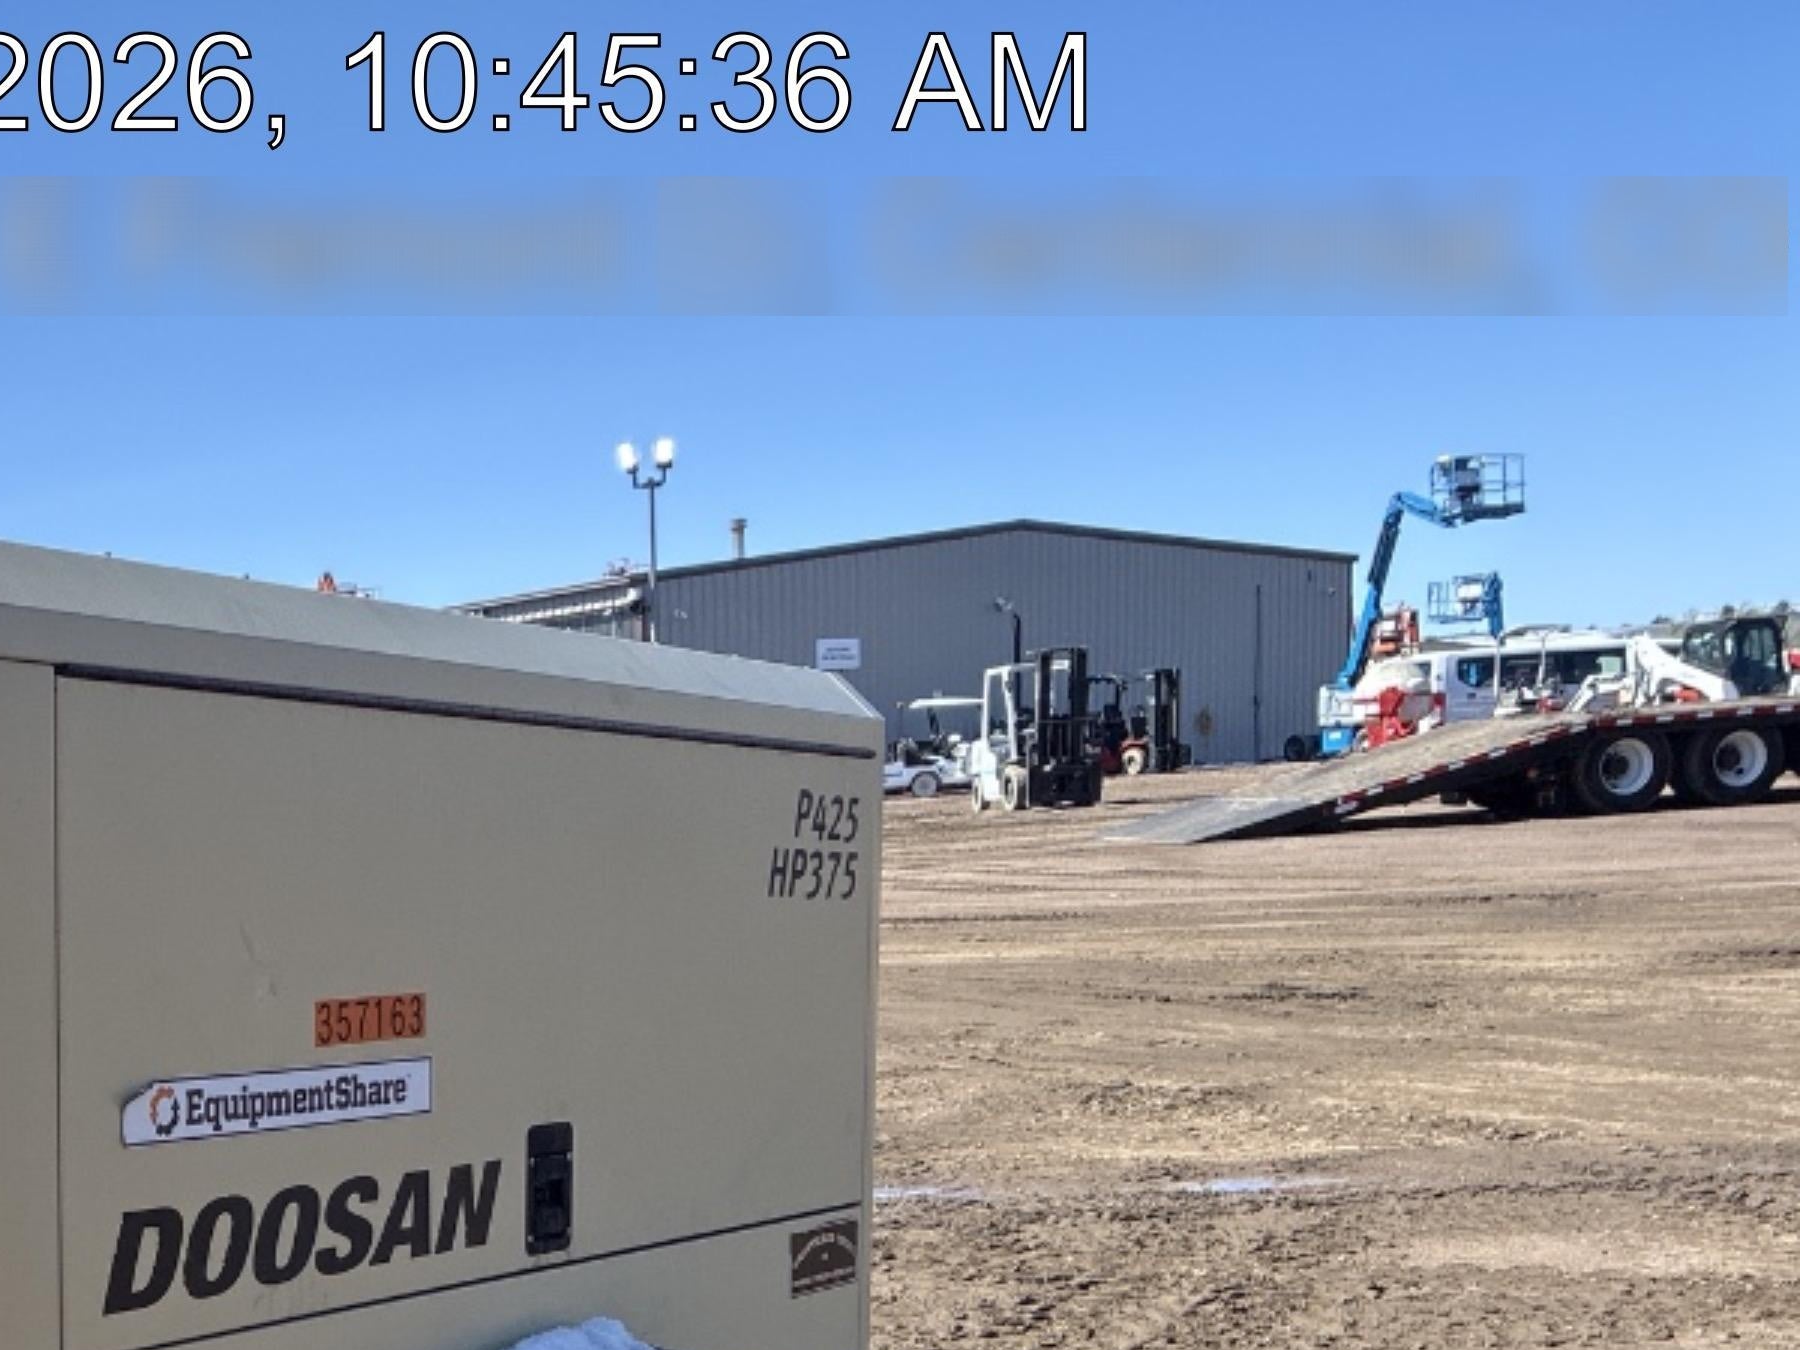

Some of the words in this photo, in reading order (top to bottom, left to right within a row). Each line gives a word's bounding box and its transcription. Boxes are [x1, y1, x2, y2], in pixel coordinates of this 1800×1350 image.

[794, 788, 860, 843] P425
[768, 846, 859, 899] HP375
[317, 995, 424, 1045] 357163
[185, 1074, 407, 1132] EquipmentShare
[102, 1158, 503, 1316] DOOSAN
